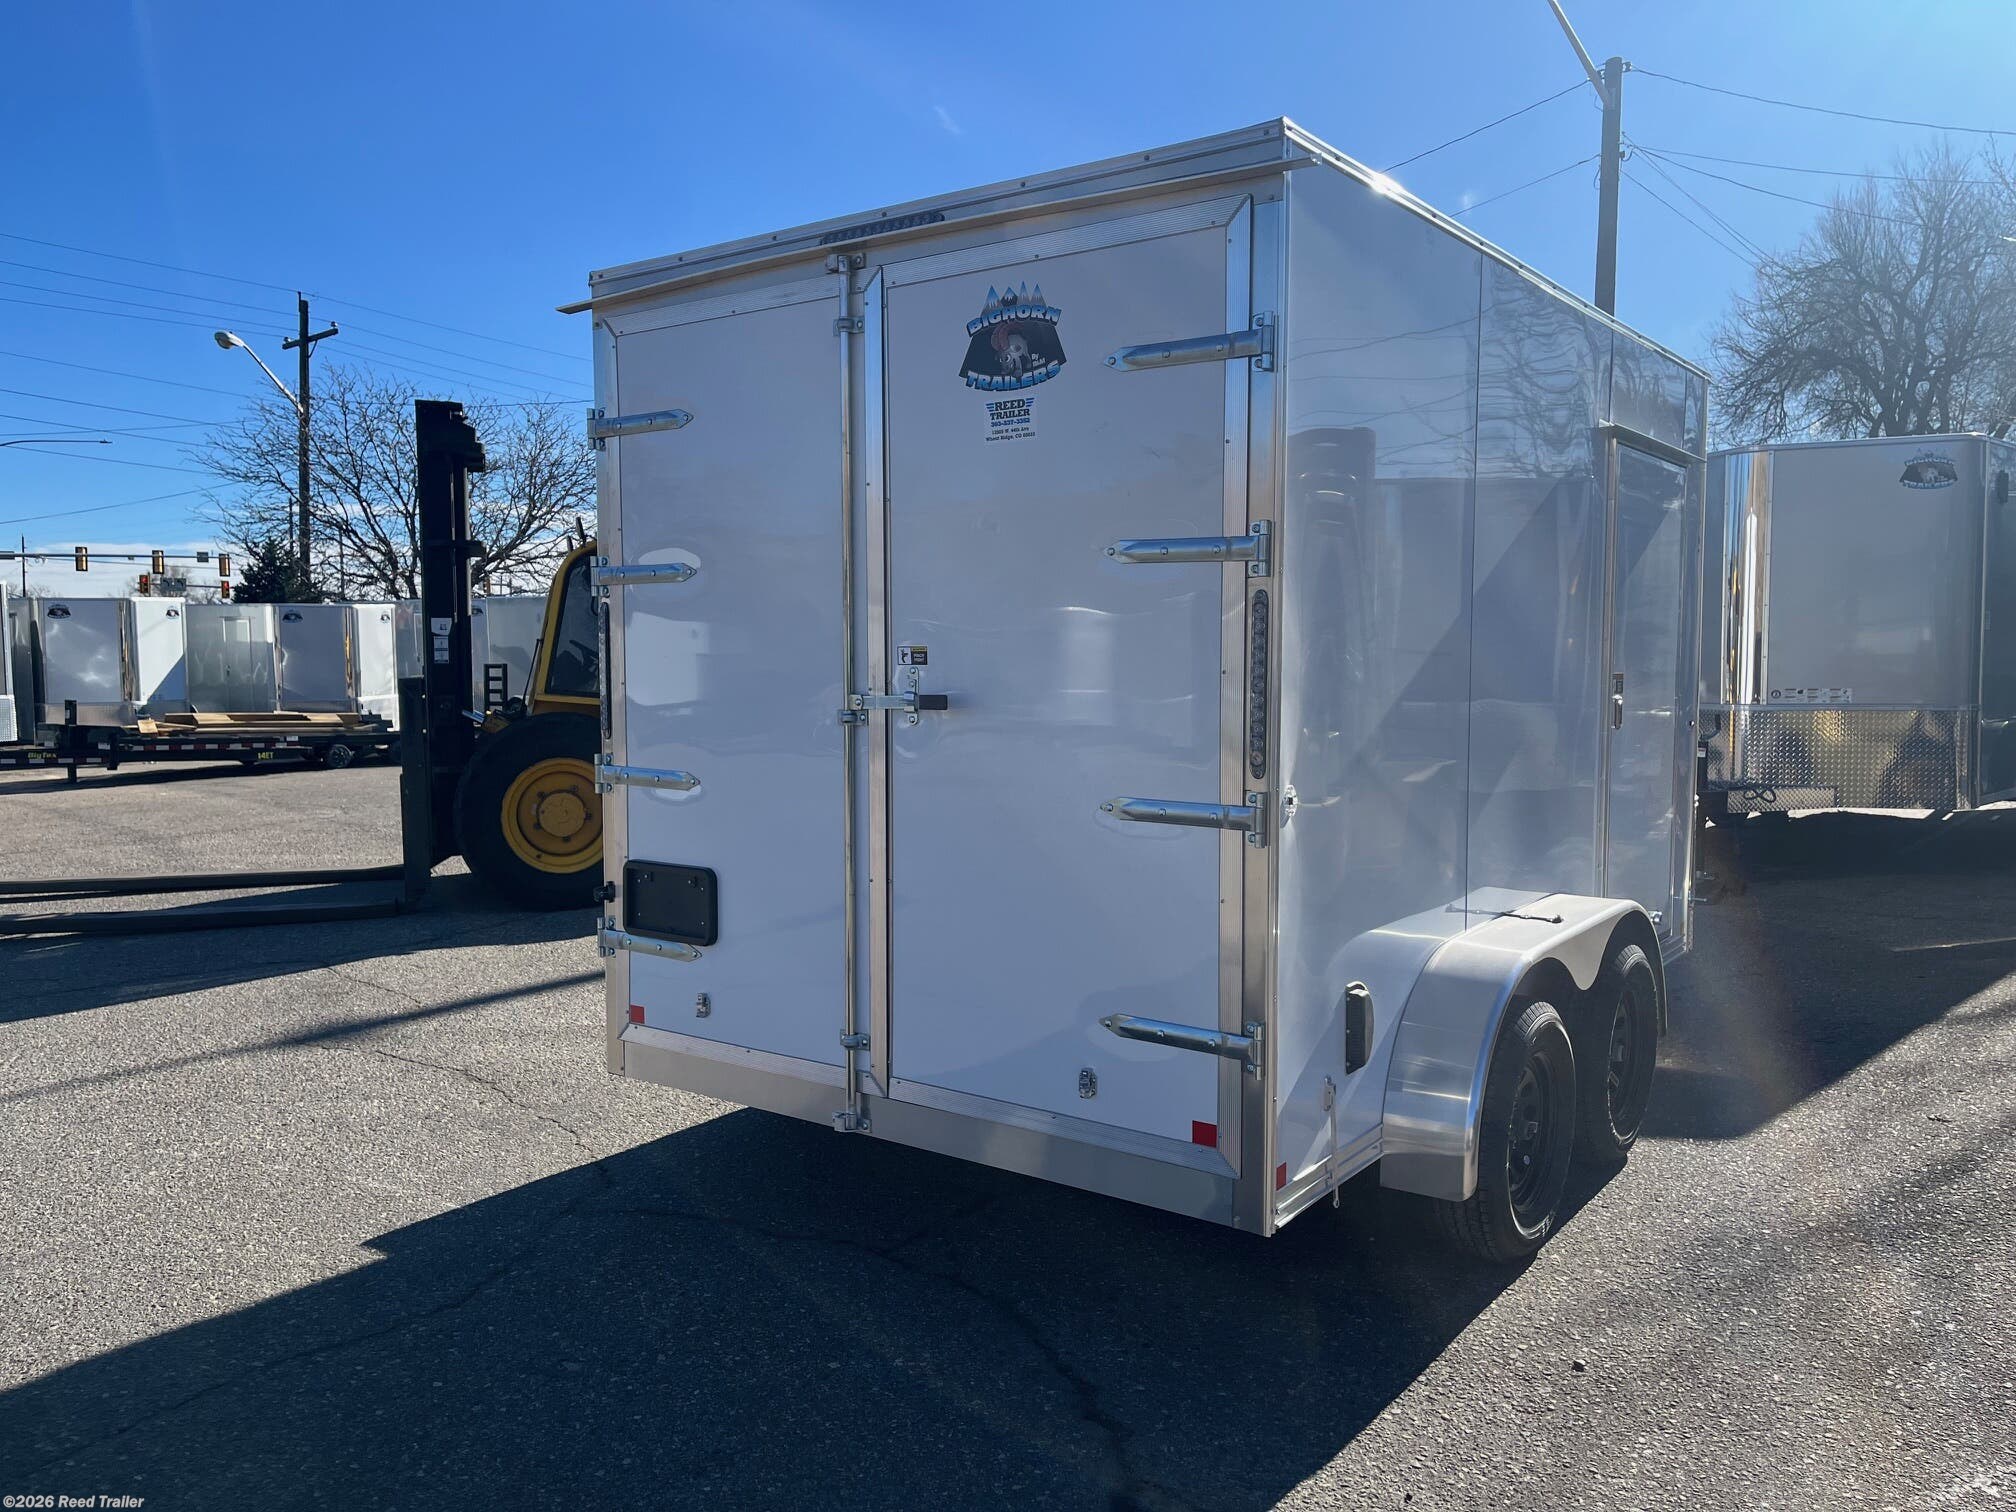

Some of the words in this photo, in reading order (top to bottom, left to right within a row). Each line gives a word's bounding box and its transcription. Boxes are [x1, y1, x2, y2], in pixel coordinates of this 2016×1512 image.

[966, 304, 1062, 337] BIGHORN
[965, 360, 1061, 392] TRAILERS
[990, 409, 1030, 420] TRAILER
[994, 399, 1025, 411] REED
